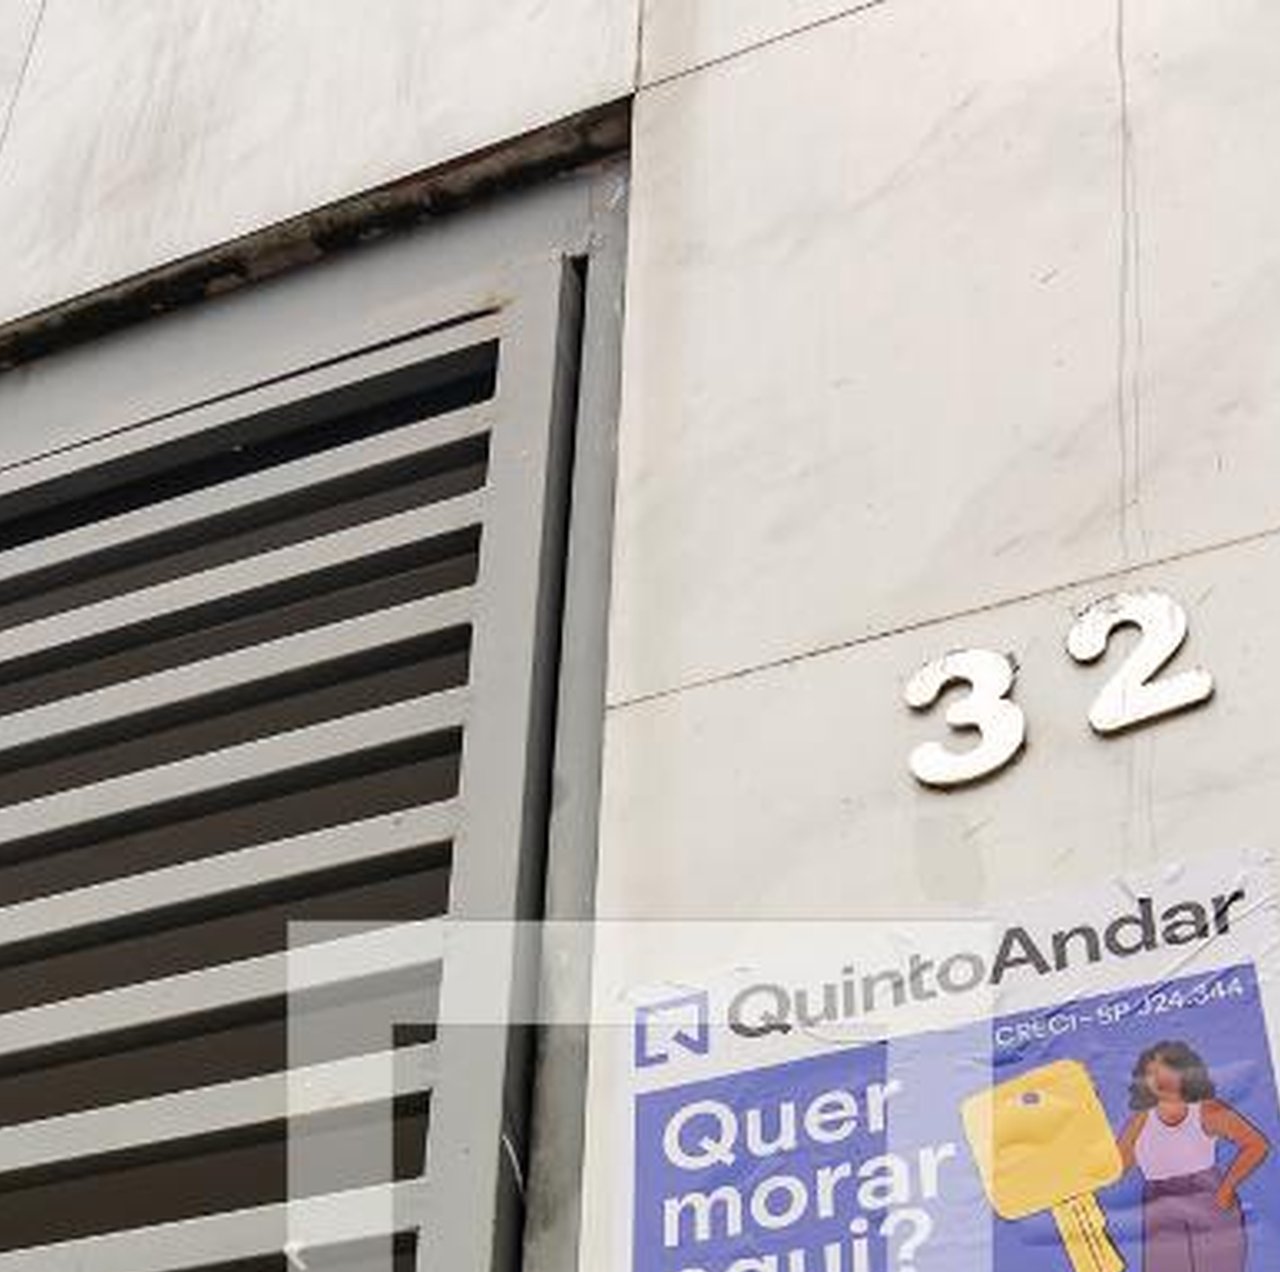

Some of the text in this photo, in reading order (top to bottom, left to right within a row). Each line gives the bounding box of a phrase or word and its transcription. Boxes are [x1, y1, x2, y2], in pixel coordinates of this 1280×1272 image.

[726, 888, 1246, 1038] QuintoAndar
[662, 1076, 902, 1175] Quer
[663, 1142, 956, 1246] morar
